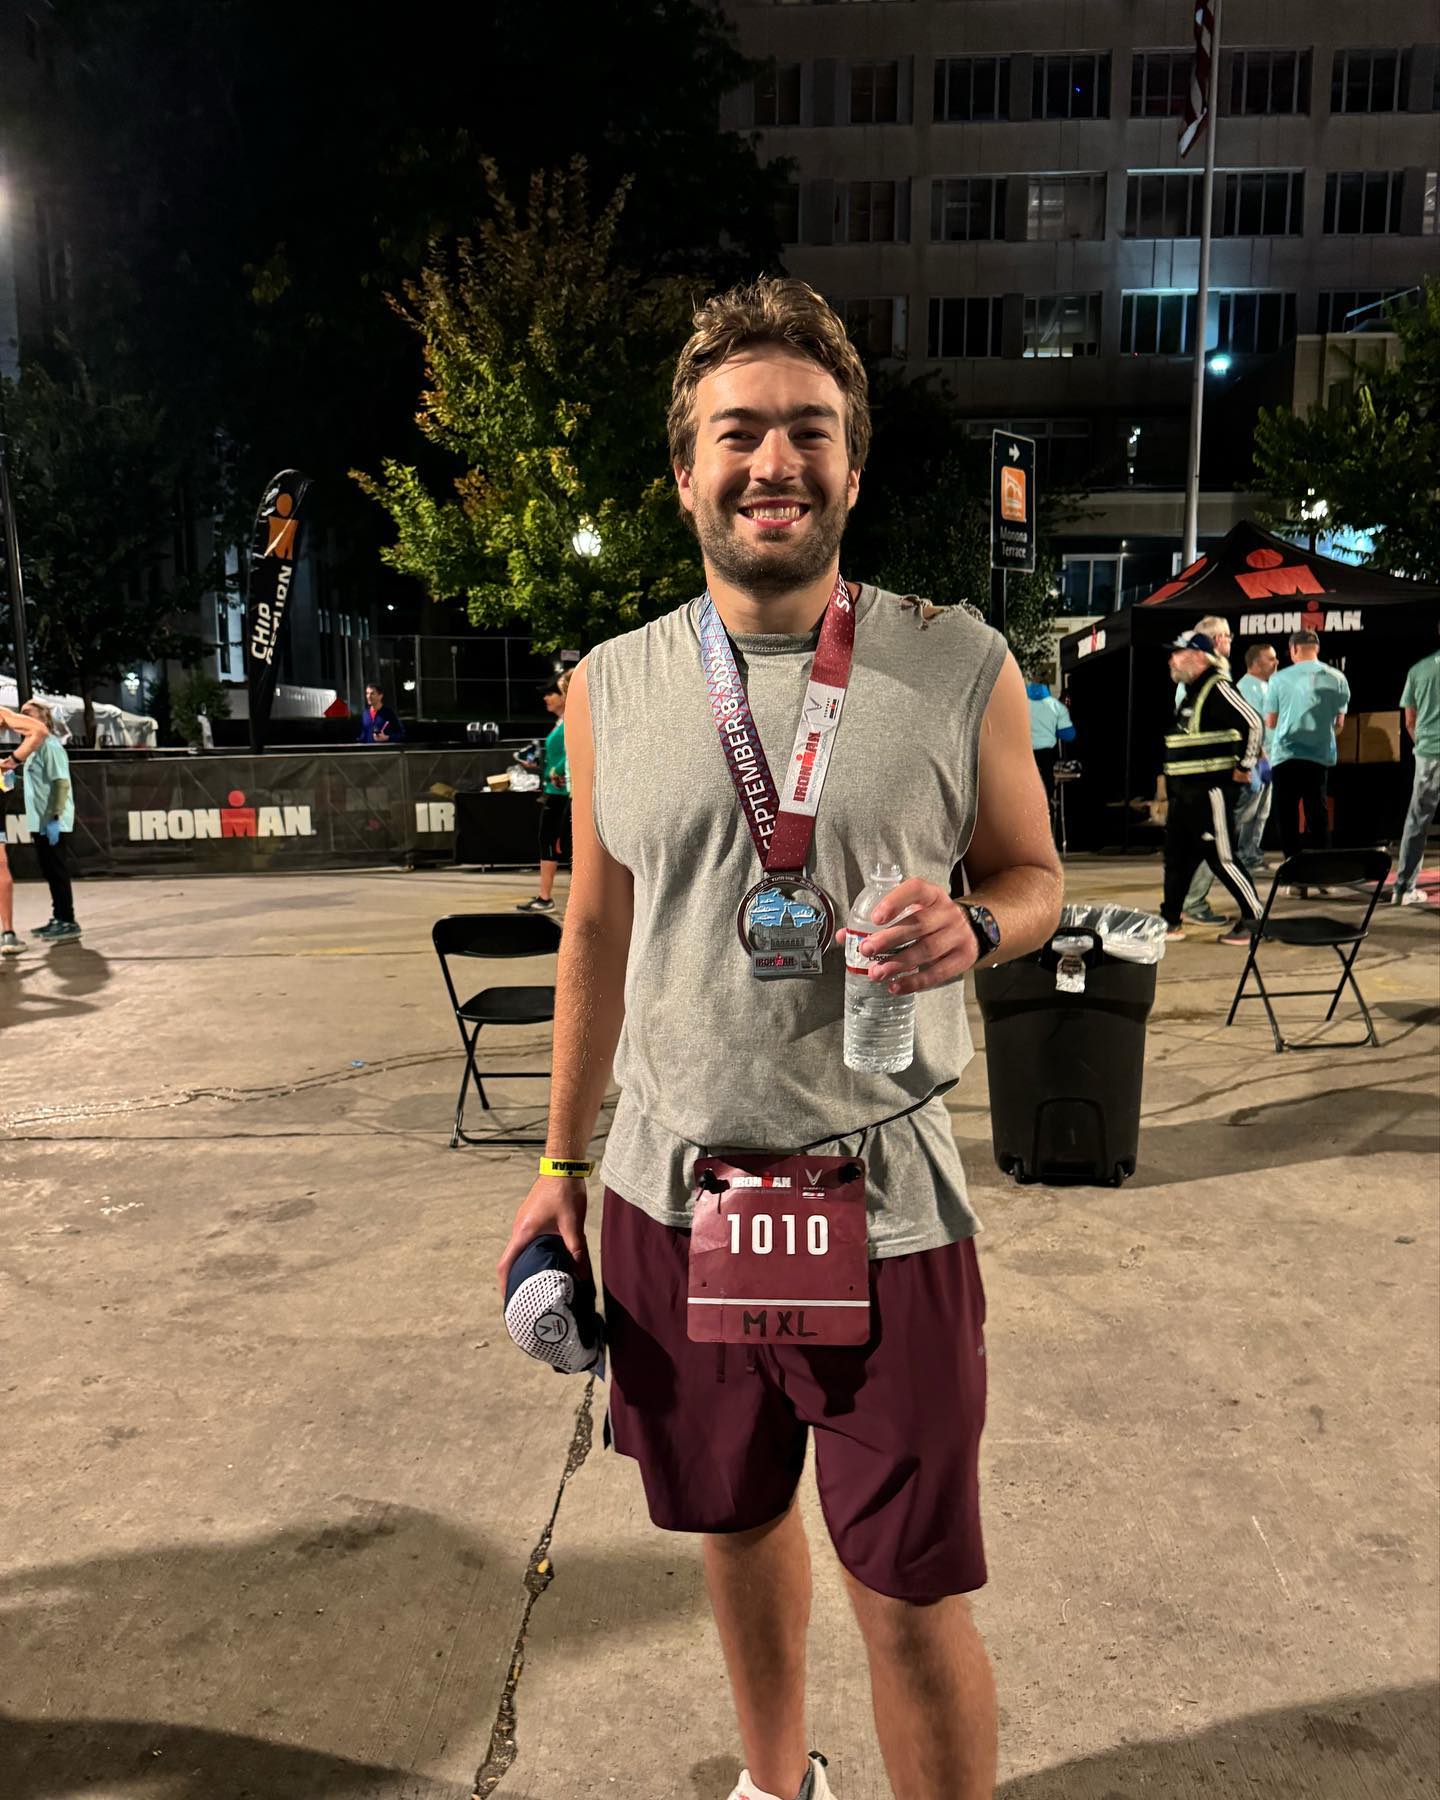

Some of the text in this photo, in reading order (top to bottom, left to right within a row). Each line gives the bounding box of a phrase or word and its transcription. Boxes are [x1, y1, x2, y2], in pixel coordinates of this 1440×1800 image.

[1000, 526, 1028, 544] Monona
[1002, 541, 1027, 559] Terrace
[251, 602, 271, 660] CHIP
[1239, 600, 1362, 635] IRONMAN
[793, 731, 821, 802] IRONMAN
[128, 790, 312, 841] IRONMAN
[732, 1171, 792, 1188] IRONMAN
[727, 1213, 829, 1256] 1010
